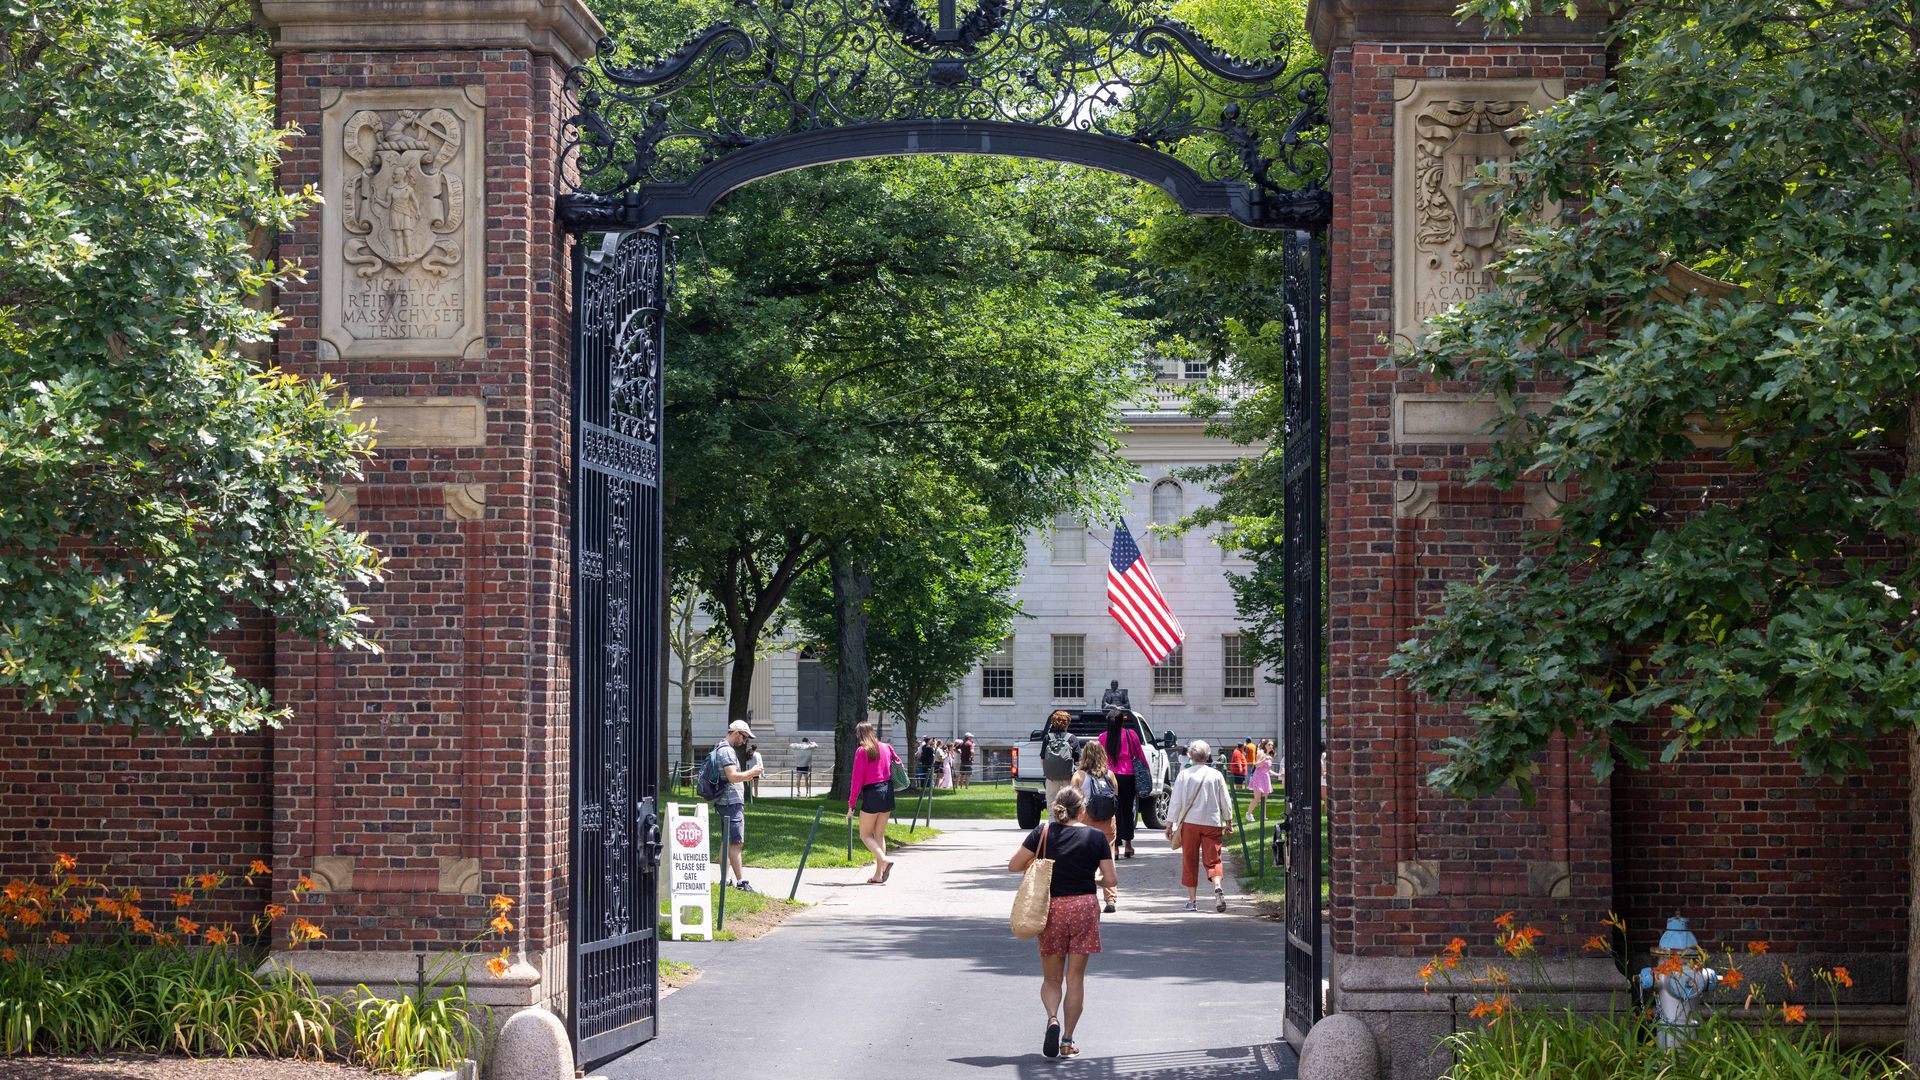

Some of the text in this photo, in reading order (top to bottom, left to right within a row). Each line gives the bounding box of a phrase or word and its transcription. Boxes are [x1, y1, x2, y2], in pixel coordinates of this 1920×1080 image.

[1440, 271, 1513, 285] SIGILLV
[365, 279, 440, 292] SIGILLVM
[348, 293, 460, 307] REIPVBLICAE
[368, 325, 438, 338] TENSIVM
[677, 829, 701, 841] STOP
[672, 852, 709, 862] ALL VEHICLES
[675, 862, 706, 871] PLEASE SEE
[684, 872, 698, 881] GATE
[676, 882, 706, 891] ATTENDANT
